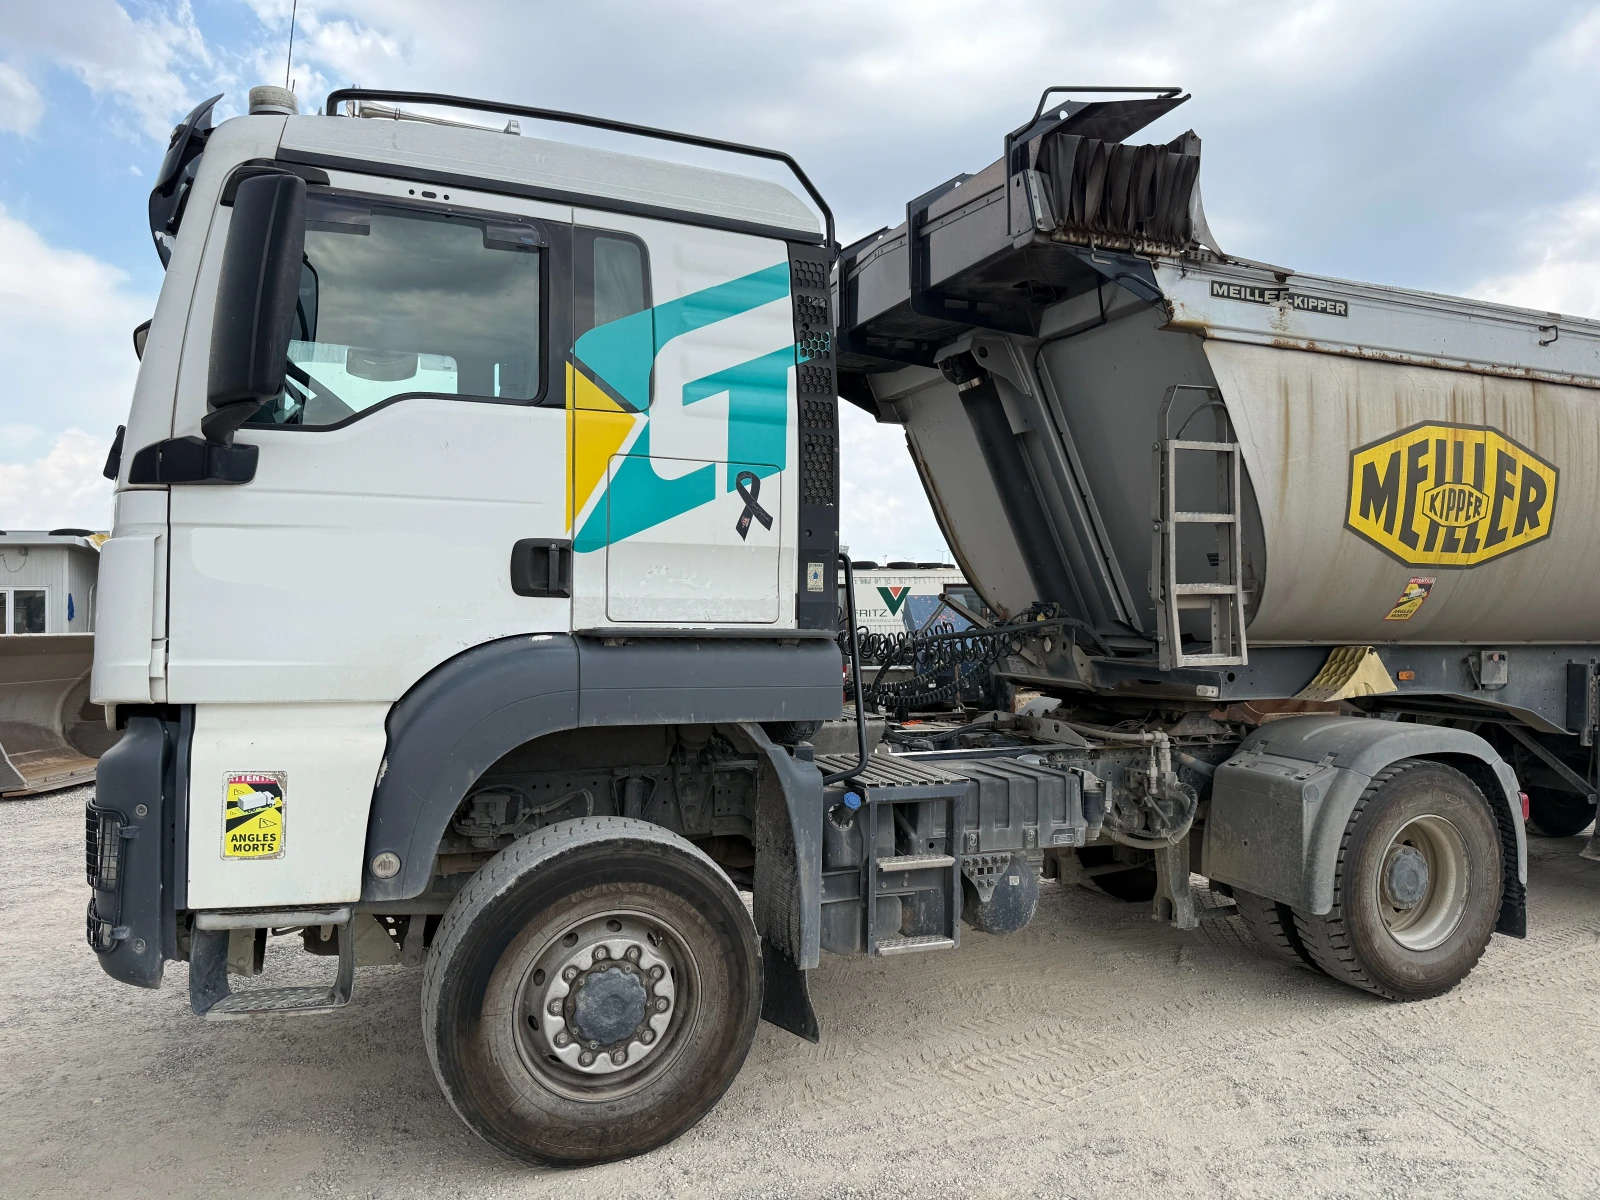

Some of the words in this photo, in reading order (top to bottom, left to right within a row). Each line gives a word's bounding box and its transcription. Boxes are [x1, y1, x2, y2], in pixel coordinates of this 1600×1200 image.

[1359, 438, 1548, 554] MEILLER
[1429, 488, 1483, 522] KIPPER
[230, 833, 277, 843] ANGLES
[233, 843, 274, 853] MORTS
